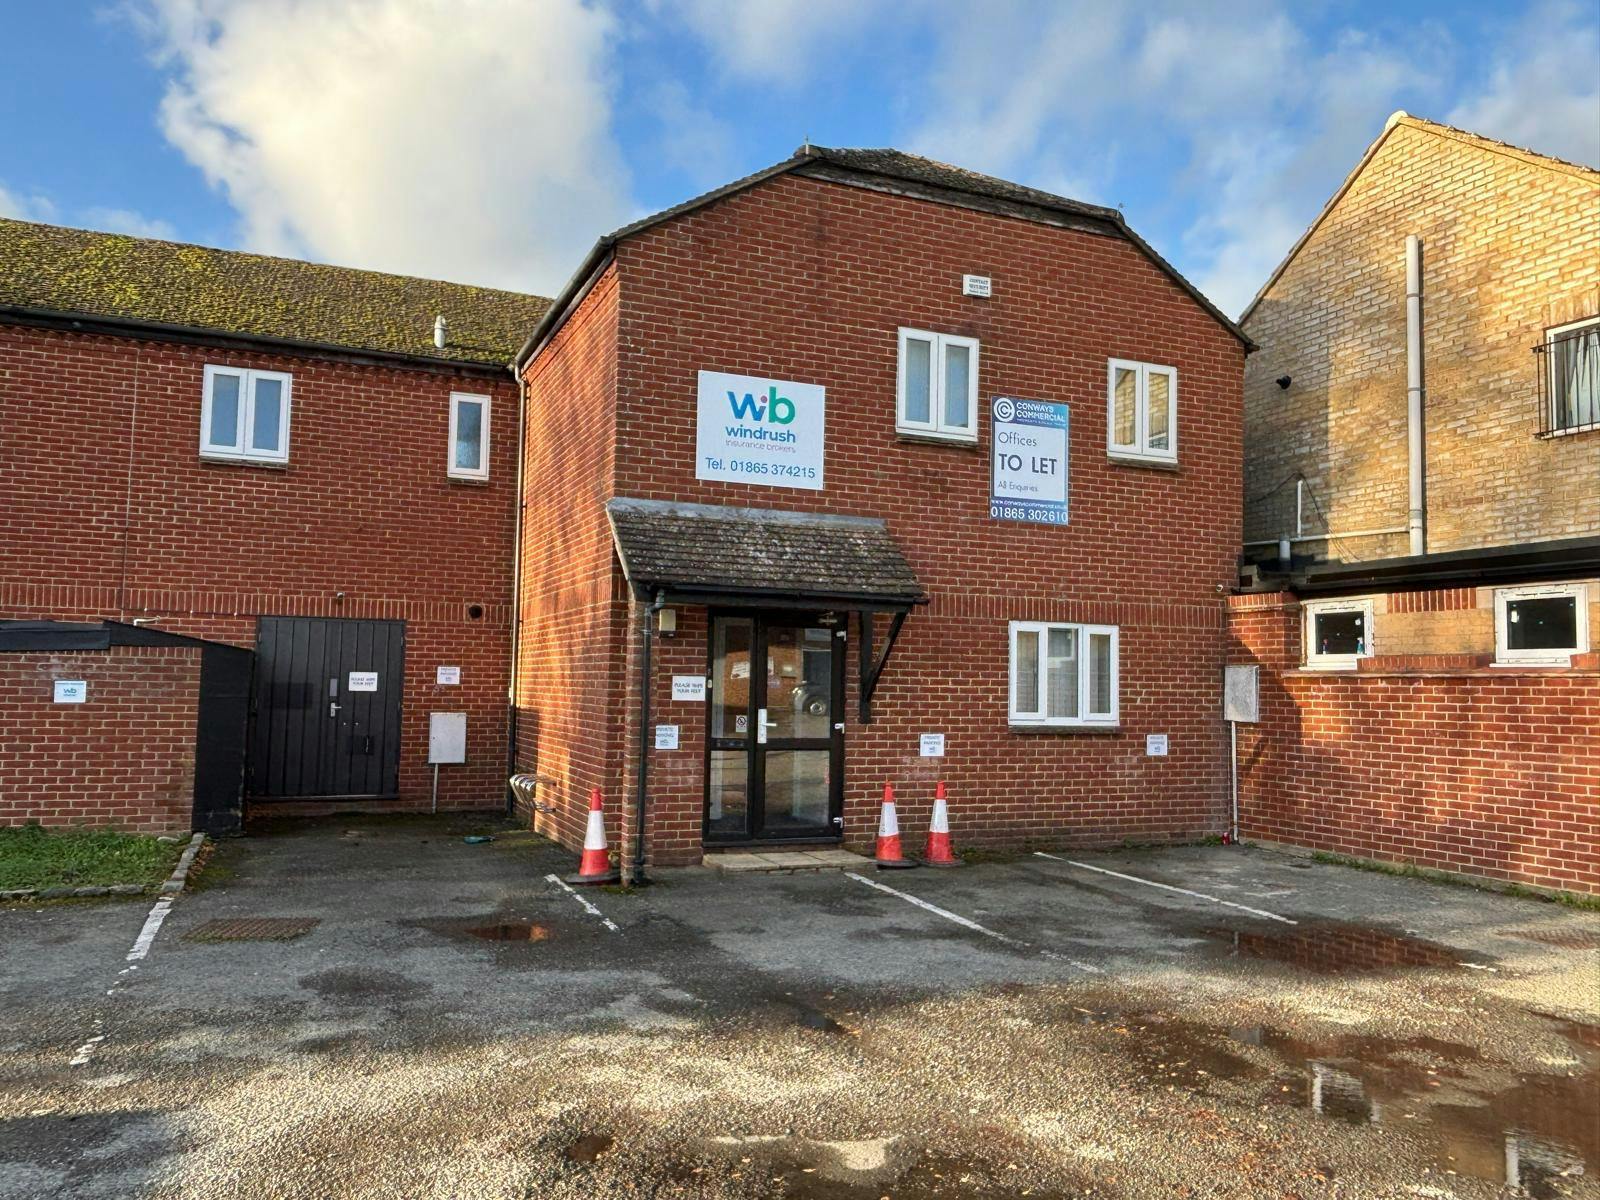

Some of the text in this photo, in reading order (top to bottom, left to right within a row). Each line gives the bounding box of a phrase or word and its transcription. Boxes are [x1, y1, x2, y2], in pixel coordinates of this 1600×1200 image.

[1016, 401, 1055, 413] CONWAYS
[1016, 410, 1066, 424] COMMERCIAL
[725, 424, 796, 443] windrush
[998, 432, 1038, 447] Offices
[725, 440, 766, 451] insurance
[705, 457, 816, 479] Tel. 01865 374215
[998, 453, 1057, 475] TO LET
[990, 506, 1068, 523] 01865 302610
